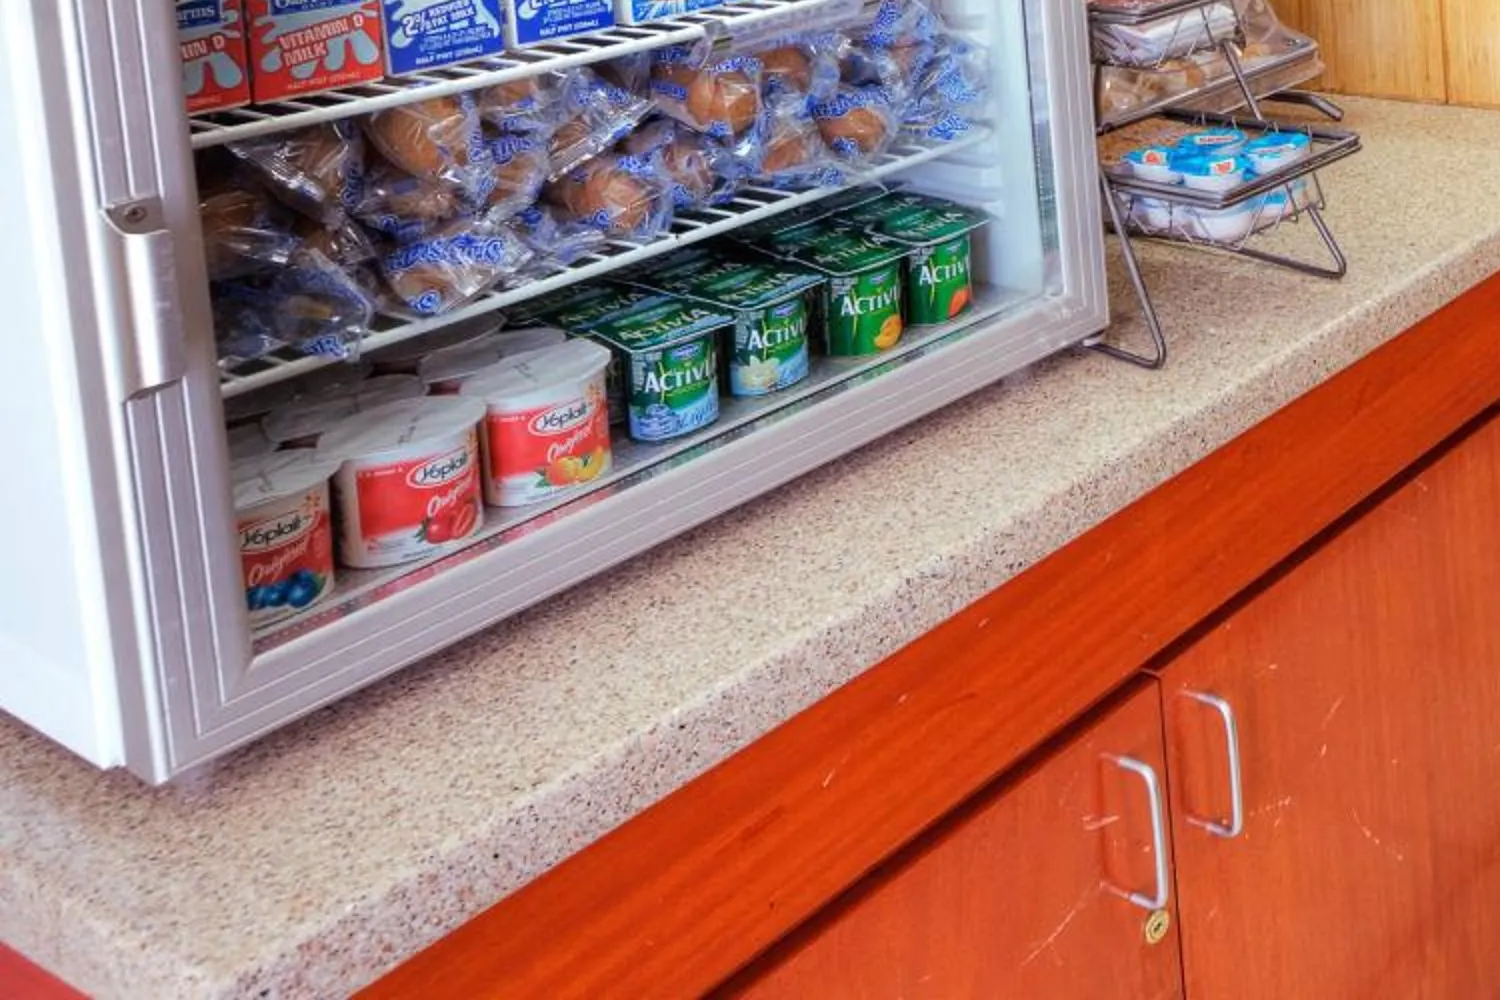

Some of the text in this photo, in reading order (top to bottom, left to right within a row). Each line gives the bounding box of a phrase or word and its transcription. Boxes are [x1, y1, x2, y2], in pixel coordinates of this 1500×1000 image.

[279, 13, 364, 49] VITAMIN D
[283, 41, 328, 67] MILK
[919, 258, 970, 287] ACTIV
[841, 285, 899, 317] ACTIVI
[747, 318, 806, 351] ACTIVI
